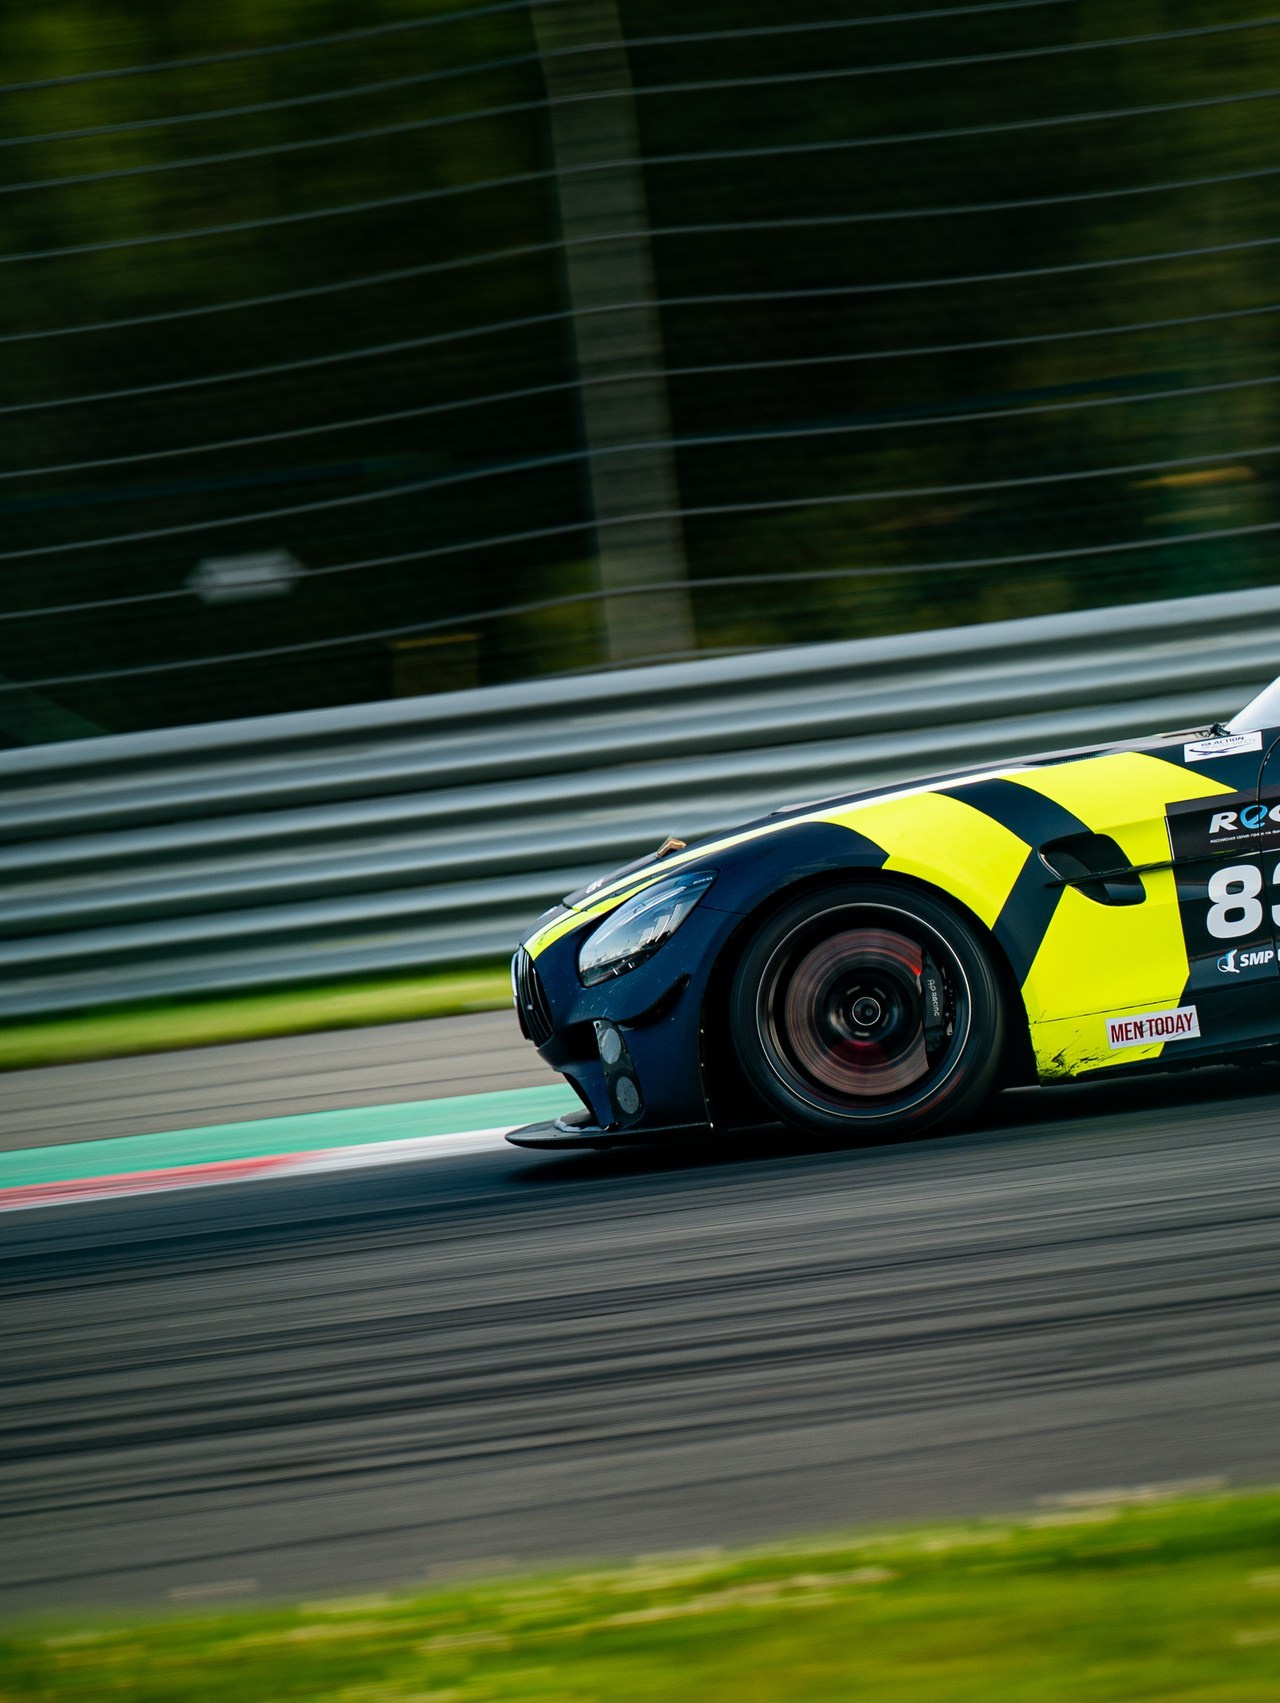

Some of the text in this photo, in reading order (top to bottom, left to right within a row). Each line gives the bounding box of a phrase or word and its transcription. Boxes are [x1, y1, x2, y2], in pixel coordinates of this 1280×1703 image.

[1240, 950, 1274, 967] SMP
[1110, 1012, 1193, 1043] MEN TODAY
